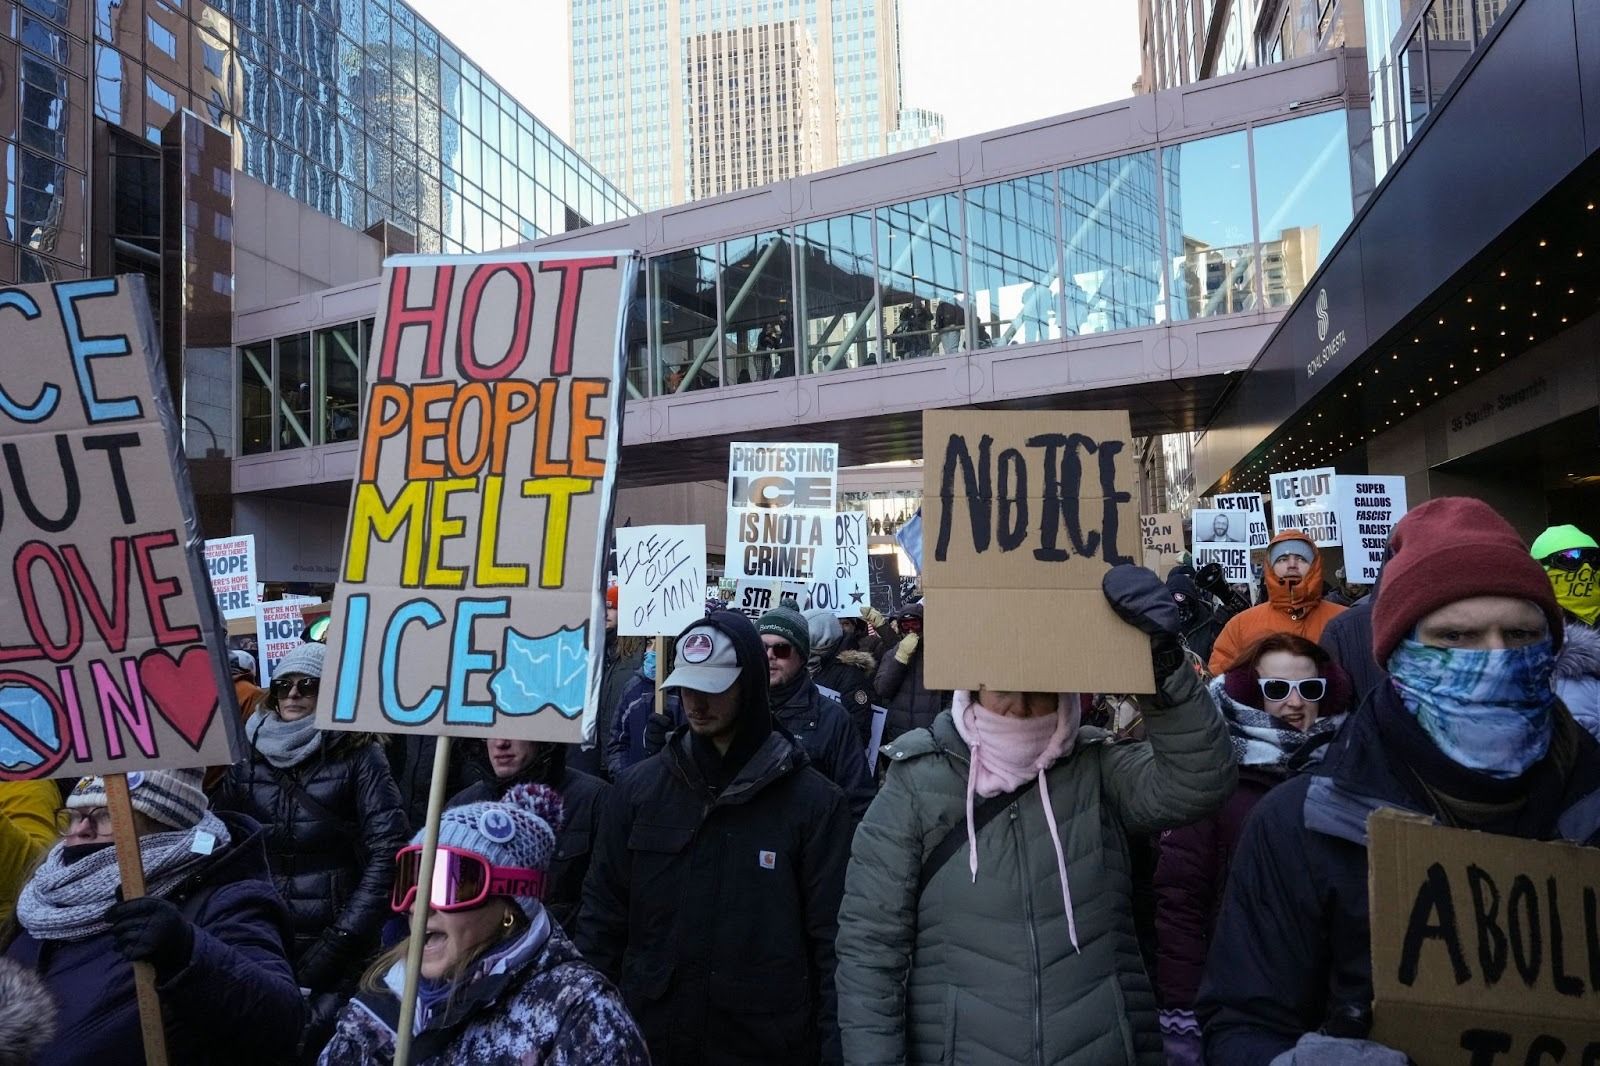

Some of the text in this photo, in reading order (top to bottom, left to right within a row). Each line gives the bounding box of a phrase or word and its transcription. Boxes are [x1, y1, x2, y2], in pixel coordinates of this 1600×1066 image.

[377, 256, 617, 380] HOT
[1322, 329, 1347, 365] SONESTA
[361, 377, 611, 482] PEOPLE
[733, 447, 834, 473] PROTESTING
[0, 432, 142, 532] UT
[1275, 474, 1330, 499] ICE OUT
[1356, 483, 1385, 494] SUPER
[732, 476, 832, 509] ICE
[1295, 497, 1316, 507] OF
[1354, 497, 1391, 507] CALLOUS
[1217, 496, 1260, 512] ICE OUT
[1140, 516, 1156, 527] NO
[1278, 511, 1337, 528] MINNESOTA
[1356, 510, 1392, 521] FASCIST
[343, 475, 593, 591] MELT
[739, 513, 822, 545] IS NOT A
[1141, 525, 1172, 537] MAN
[1303, 525, 1337, 542] GOOD!
[1358, 524, 1391, 535] RACIST
[234, 540, 247, 548] HERE
[1144, 537, 1153, 545] IS
[207, 554, 249, 576] HOPE
[620, 534, 668, 584] ICE
[645, 540, 684, 586] OUT
[743, 545, 815, 578] CRIME!
[836, 546, 858, 567] ITS
[1196, 548, 1246, 566] JUSTICE
[836, 562, 851, 578] ON
[231, 576, 248, 585] HOPE
[1567, 582, 1594, 597] ICE
[0, 529, 203, 662] OVE
[634, 567, 698, 628] OF MN!
[263, 606, 284, 615] WE'RE
[284, 604, 297, 613] NOT
[264, 613, 291, 622] BECAUSE
[267, 641, 296, 651] THERE'S
[332, 592, 511, 727] ICE
[58, 656, 159, 763] IN
[490, 878, 539, 897] GIRO
[1398, 862, 1600, 999] ABOLI
